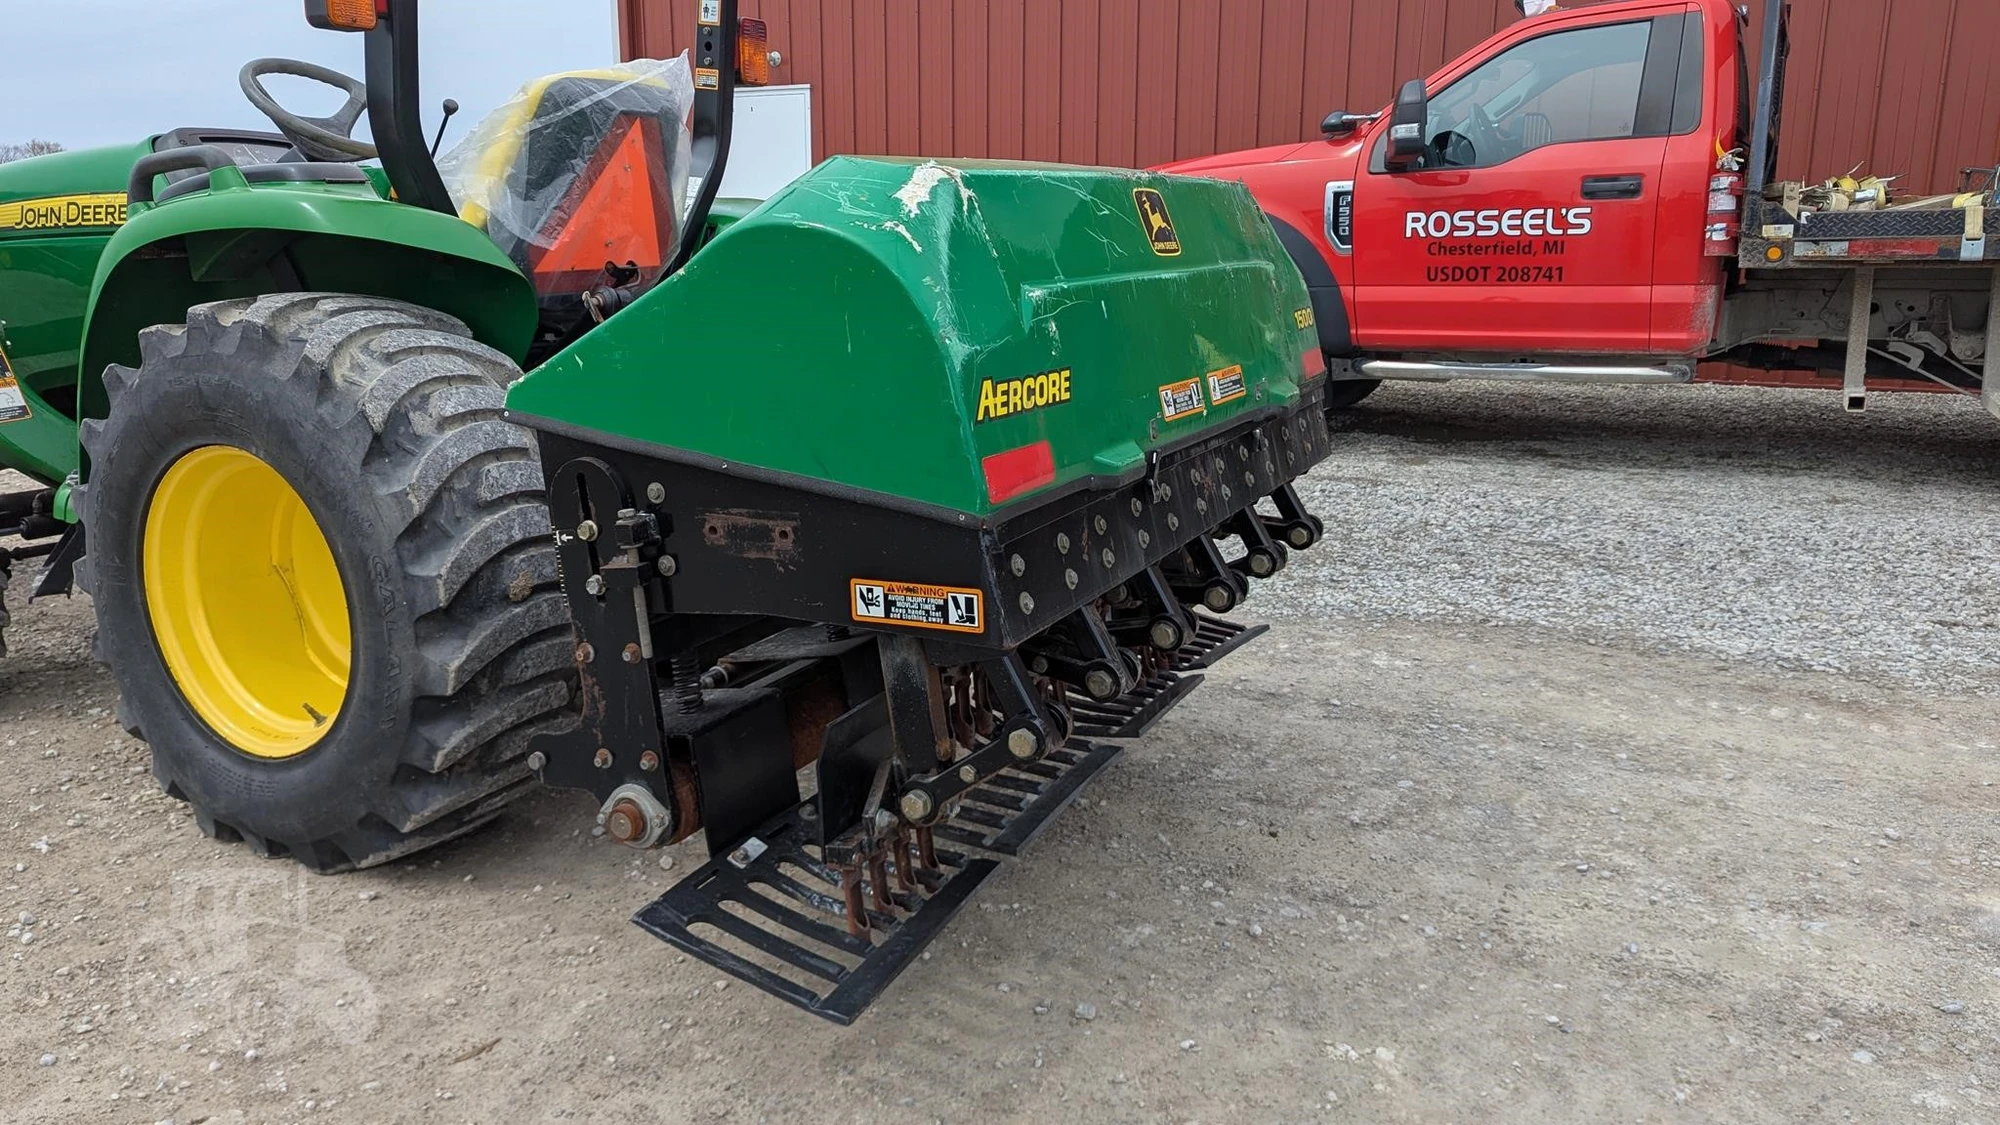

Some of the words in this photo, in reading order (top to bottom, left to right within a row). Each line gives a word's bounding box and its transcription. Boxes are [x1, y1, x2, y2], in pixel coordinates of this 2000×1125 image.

[15, 204, 62, 226] JOHN
[66, 201, 128, 223] DEERE
[1339, 195, 1351, 235] F550
[1404, 207, 1593, 238] ROSSEEL'S
[1427, 240, 1538, 257] Chesterfield,
[1543, 240, 1565, 255] MI
[1426, 266, 1491, 282] USDOT
[1495, 266, 1564, 282] 208741
[1293, 307, 1314, 329] 1500
[976, 369, 1071, 422] AERCORE
[896, 584, 945, 597] WARNING
[926, 616, 944, 624] away
